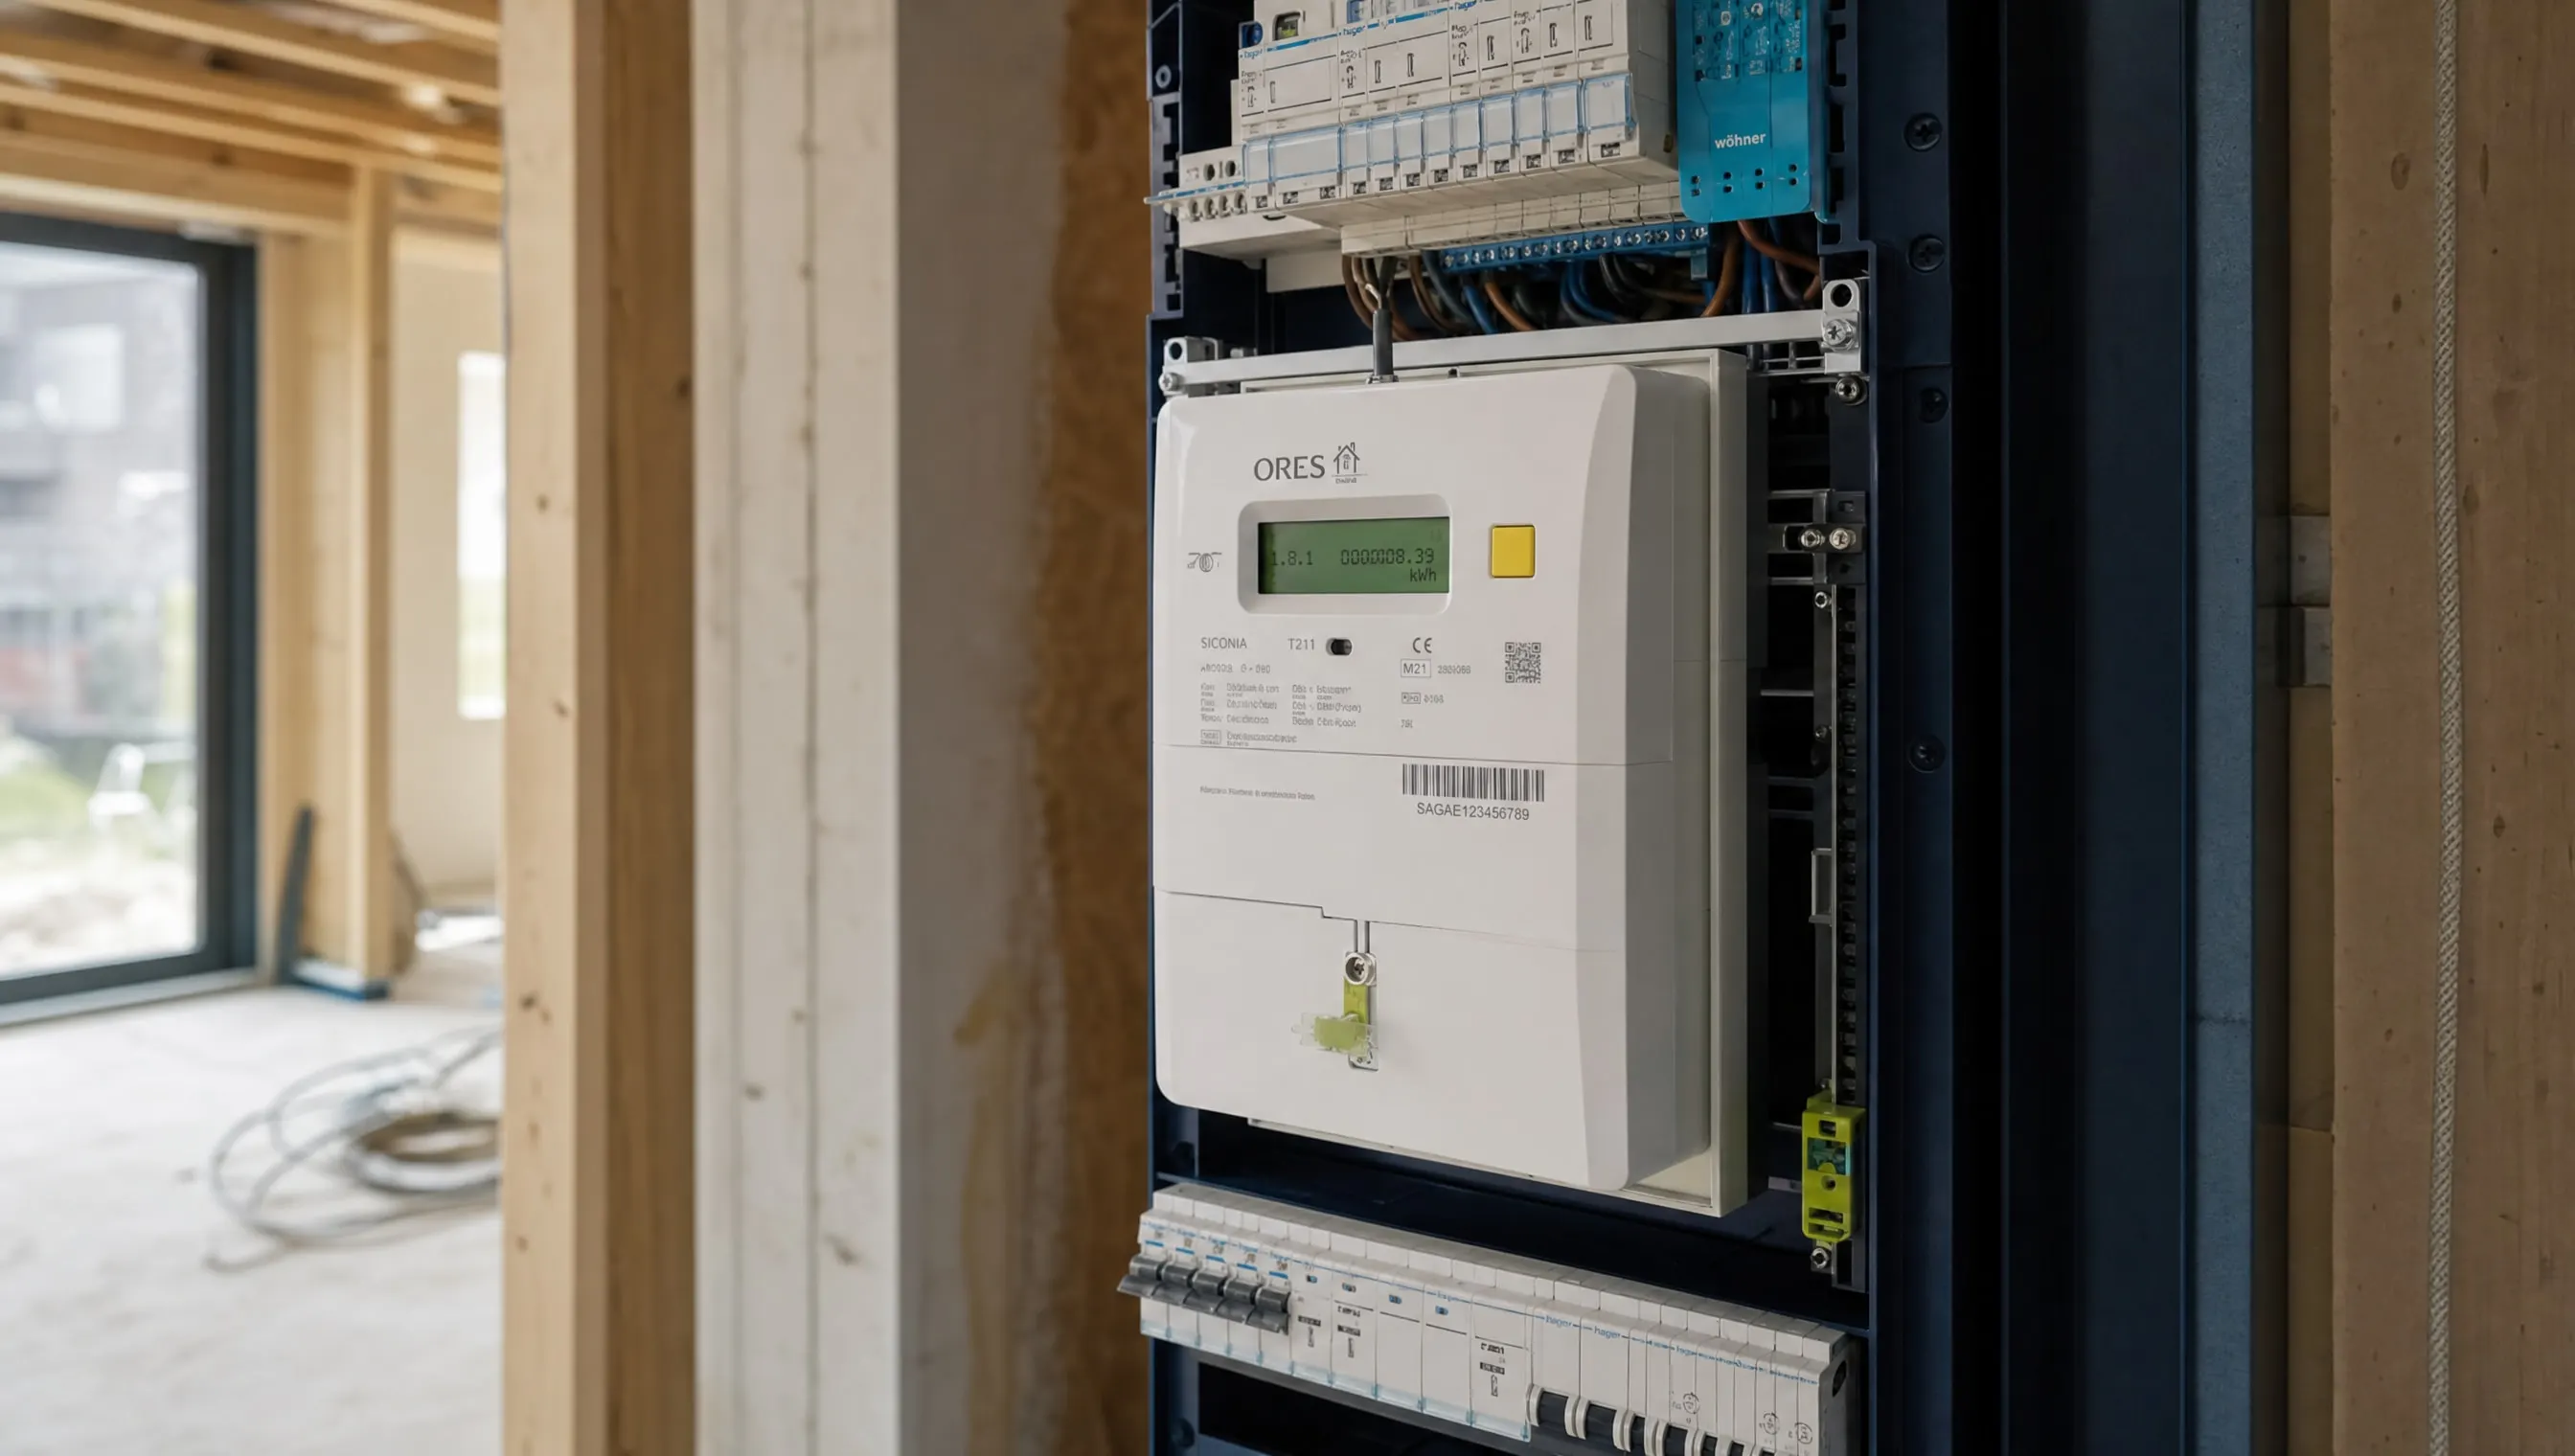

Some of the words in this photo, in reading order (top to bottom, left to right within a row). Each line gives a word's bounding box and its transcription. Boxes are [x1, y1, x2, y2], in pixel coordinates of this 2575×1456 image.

[1715, 132, 1766, 148] wöhner
[1253, 455, 1326, 482] ORES
[1271, 550, 1313, 566] 1.8.1
[1409, 568, 1437, 582] kWh
[1200, 637, 1248, 650] SICONIA
[1288, 638, 1315, 651] T211
[1402, 663, 1427, 674] M21
[1417, 802, 1530, 821] SAGAE123456789
[1594, 1325, 1621, 1339] hager
